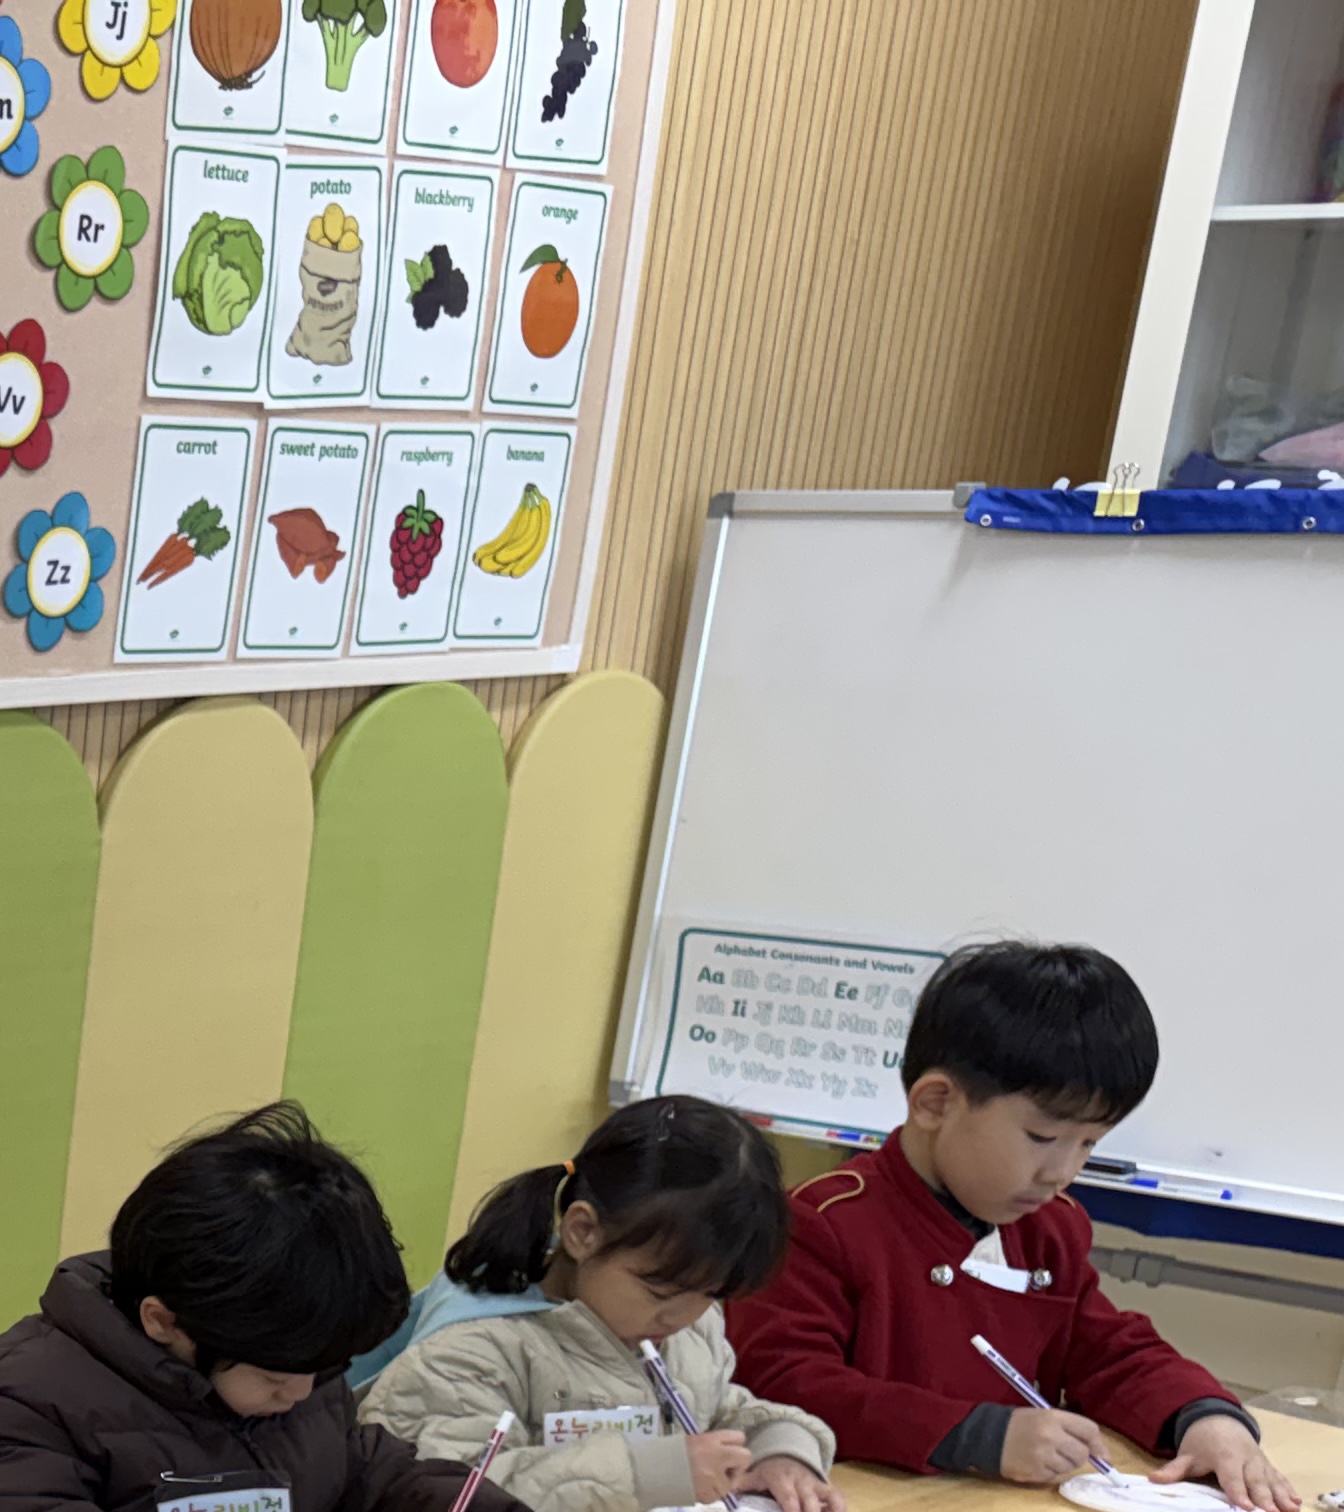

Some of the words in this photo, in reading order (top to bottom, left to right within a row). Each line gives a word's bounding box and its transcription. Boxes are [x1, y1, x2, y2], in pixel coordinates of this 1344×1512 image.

[105, 0, 129, 41] Jj
[203, 159, 249, 183] lettuce
[309, 179, 353, 200] potato
[414, 187, 475, 213] blackberry
[541, 204, 579, 225] orange
[77, 213, 105, 244] Rr
[175, 439, 218, 455] carrot
[279, 442, 316, 457] sweet
[316, 442, 360, 463] potato
[400, 446, 454, 467] raspberry
[506, 444, 545, 463] banana
[44, 559, 72, 586] Zz
[844, 958, 867, 970] and
[871, 960, 915, 974] Vowels
[698, 966, 725, 984] Aa
[834, 981, 858, 1000] Ee
[732, 999, 747, 1017] Ii
[689, 1024, 716, 1043] Oo
